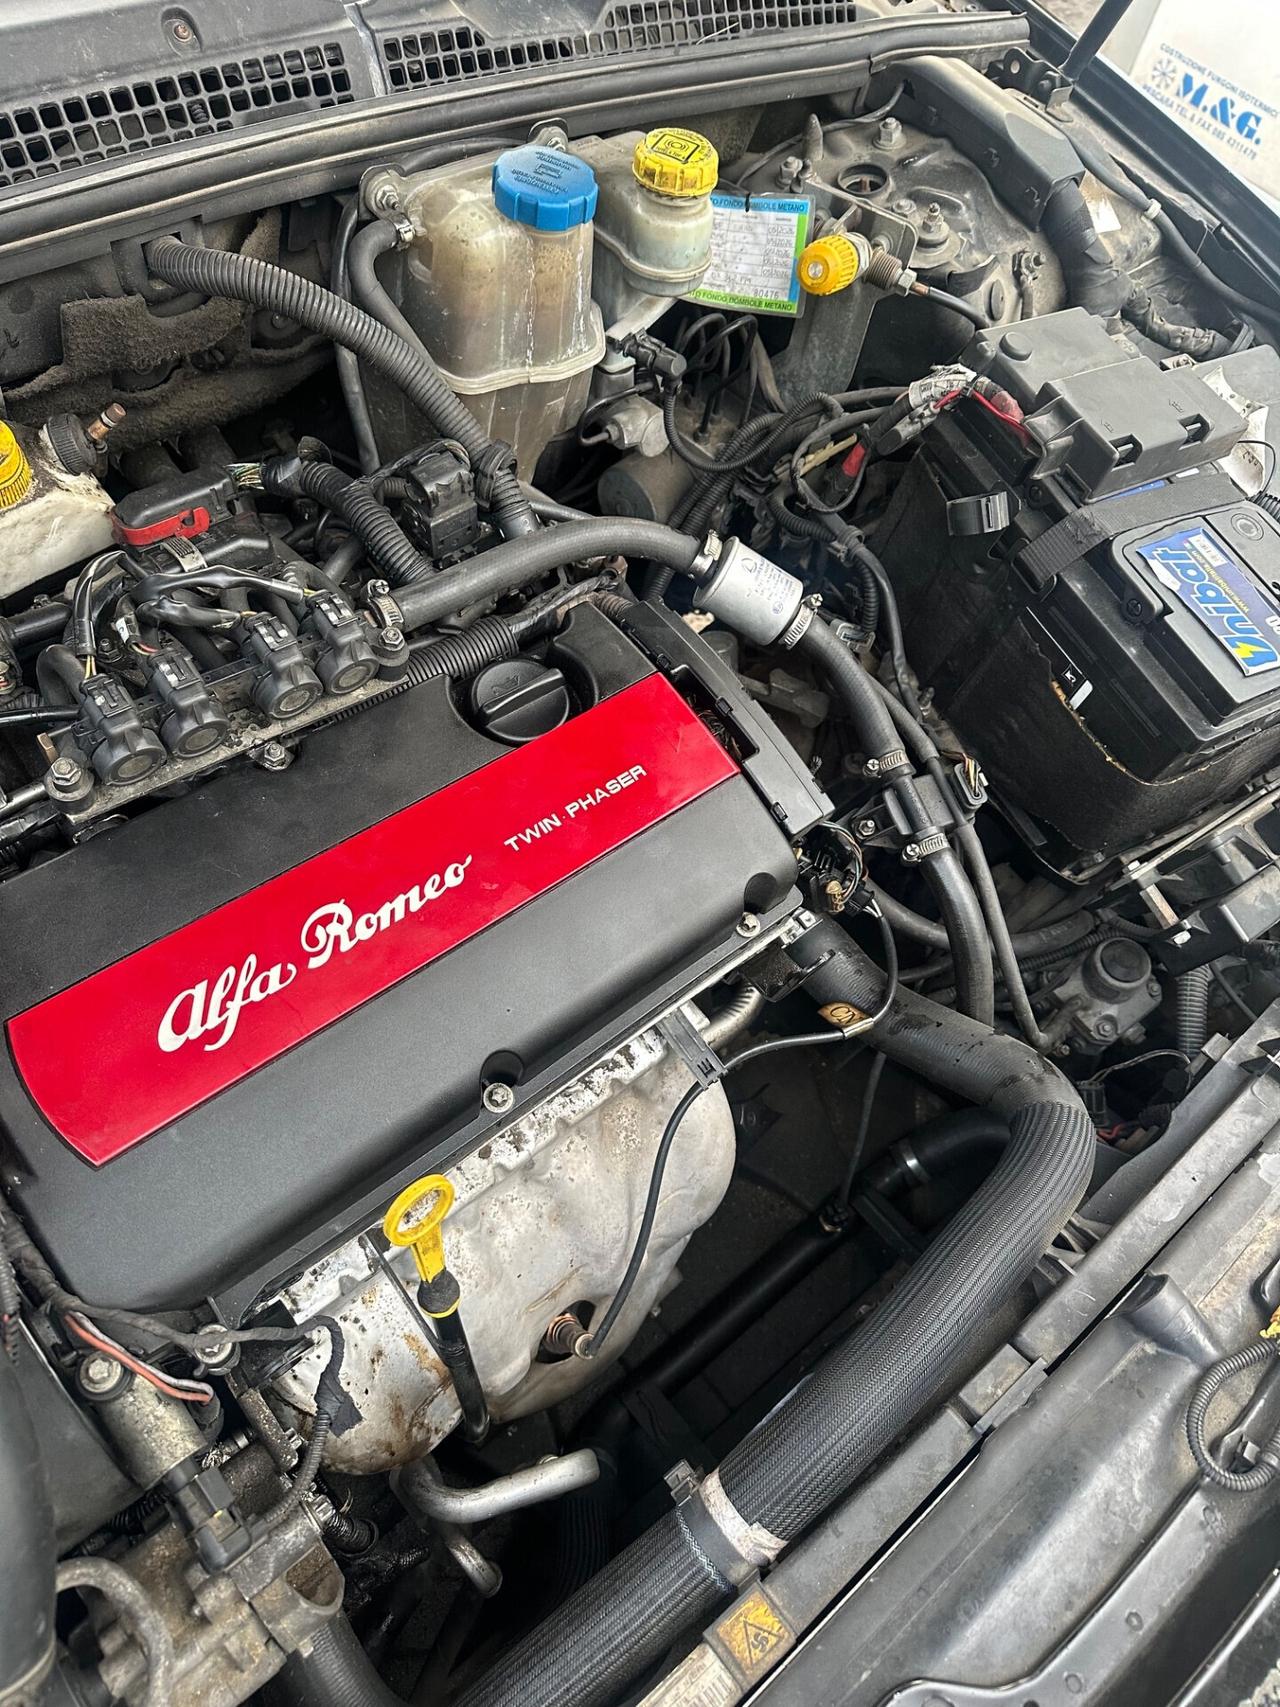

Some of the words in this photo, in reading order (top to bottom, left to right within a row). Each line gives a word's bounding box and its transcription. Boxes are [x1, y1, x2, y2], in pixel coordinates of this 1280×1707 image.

[777, 202, 805, 212] METANO
[764, 301, 792, 311] METANO
[1152, 547, 1280, 668] Unibat
[504, 812, 562, 852] TWIN
[564, 764, 647, 819] PHASER
[157, 953, 297, 1053] Alfa
[301, 854, 473, 969] Romeo
